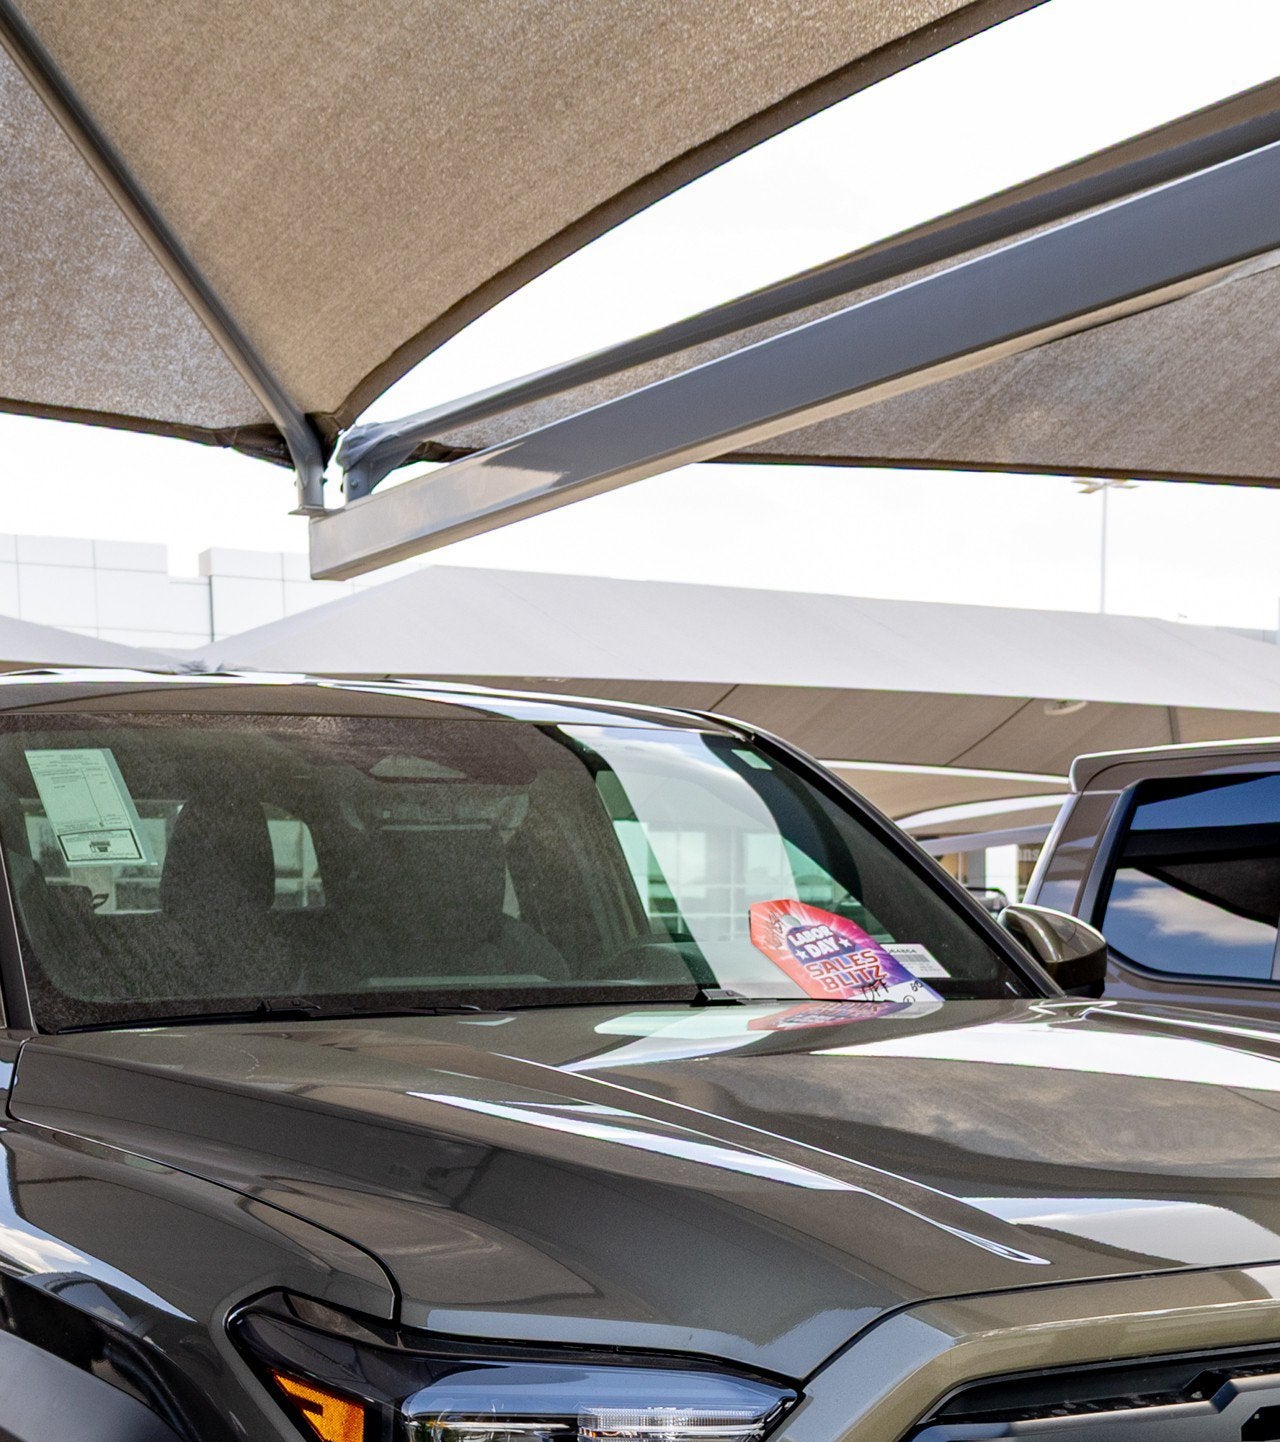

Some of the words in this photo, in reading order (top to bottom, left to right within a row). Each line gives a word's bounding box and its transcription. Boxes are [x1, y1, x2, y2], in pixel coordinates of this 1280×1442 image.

[787, 925, 833, 947] LABOR
[804, 937, 841, 958] DAY
[805, 949, 879, 978] SALES
[816, 965, 888, 992] BLITZ
